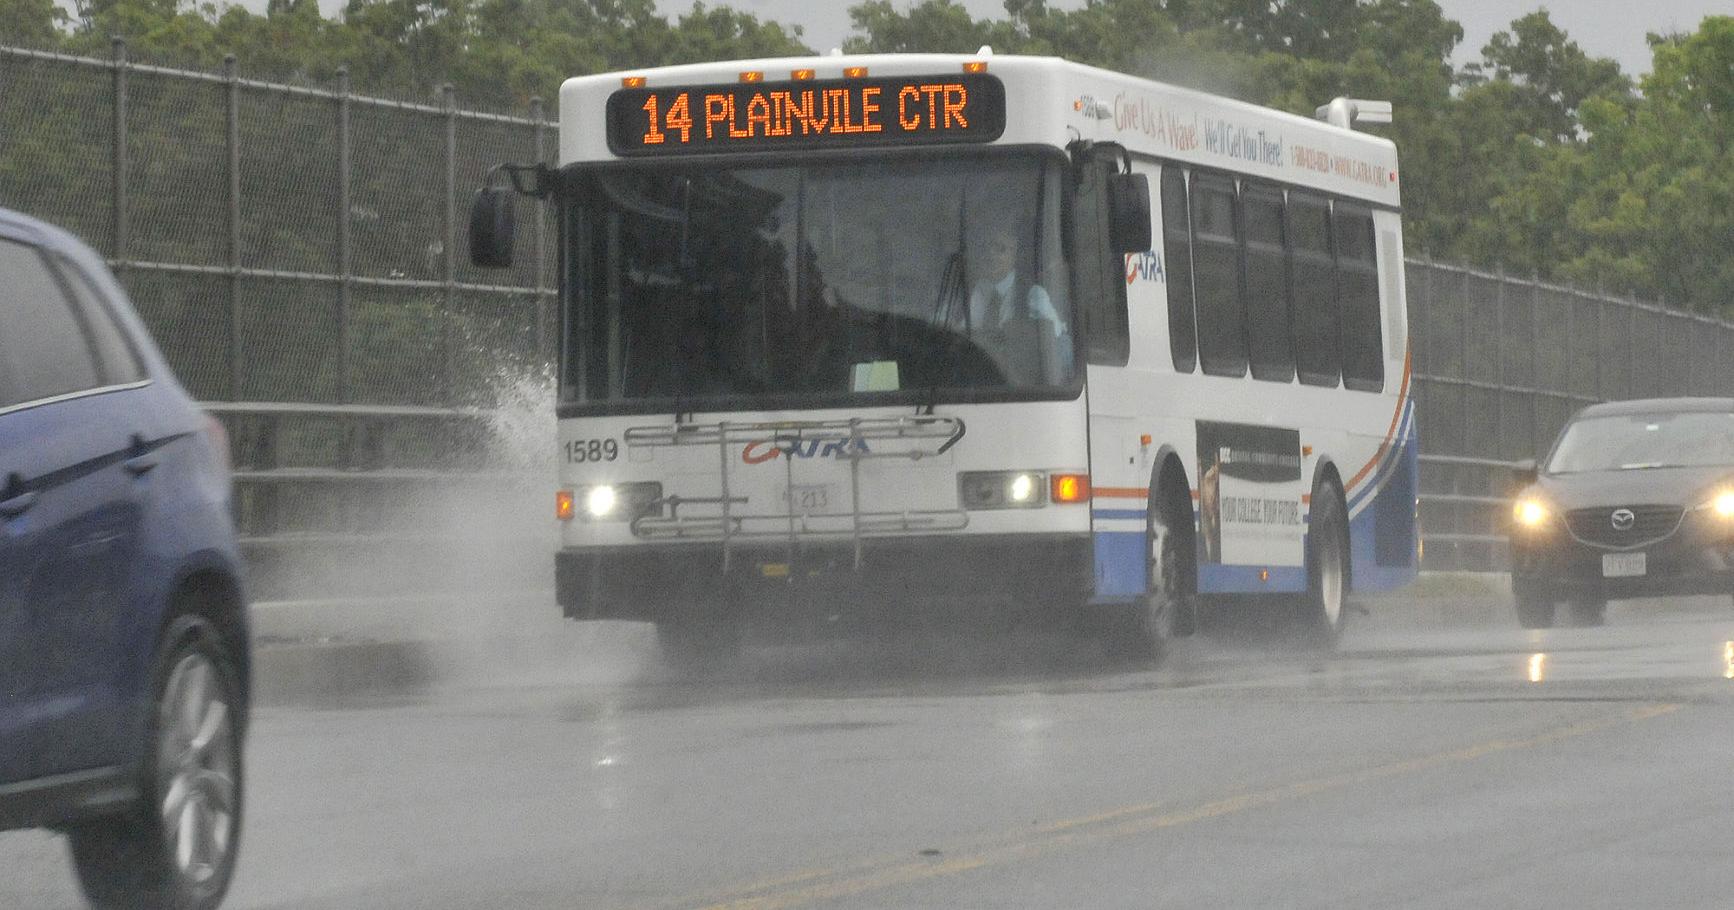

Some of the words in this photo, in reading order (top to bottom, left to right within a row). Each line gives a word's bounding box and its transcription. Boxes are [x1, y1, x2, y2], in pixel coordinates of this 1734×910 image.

[643, 93, 692, 144] 14
[705, 87, 881, 139] PLAINVILE
[899, 84, 967, 130] CTR
[1114, 93, 1138, 131] Give
[1141, 97, 1157, 138] Us
[1157, 106, 1167, 144] A
[1167, 111, 1199, 152] Wave!
[1204, 120, 1226, 154] We'll
[1227, 124, 1242, 159] Get
[1242, 127, 1257, 162] You
[1257, 131, 1284, 168] There!
[564, 438, 618, 462] 1589
